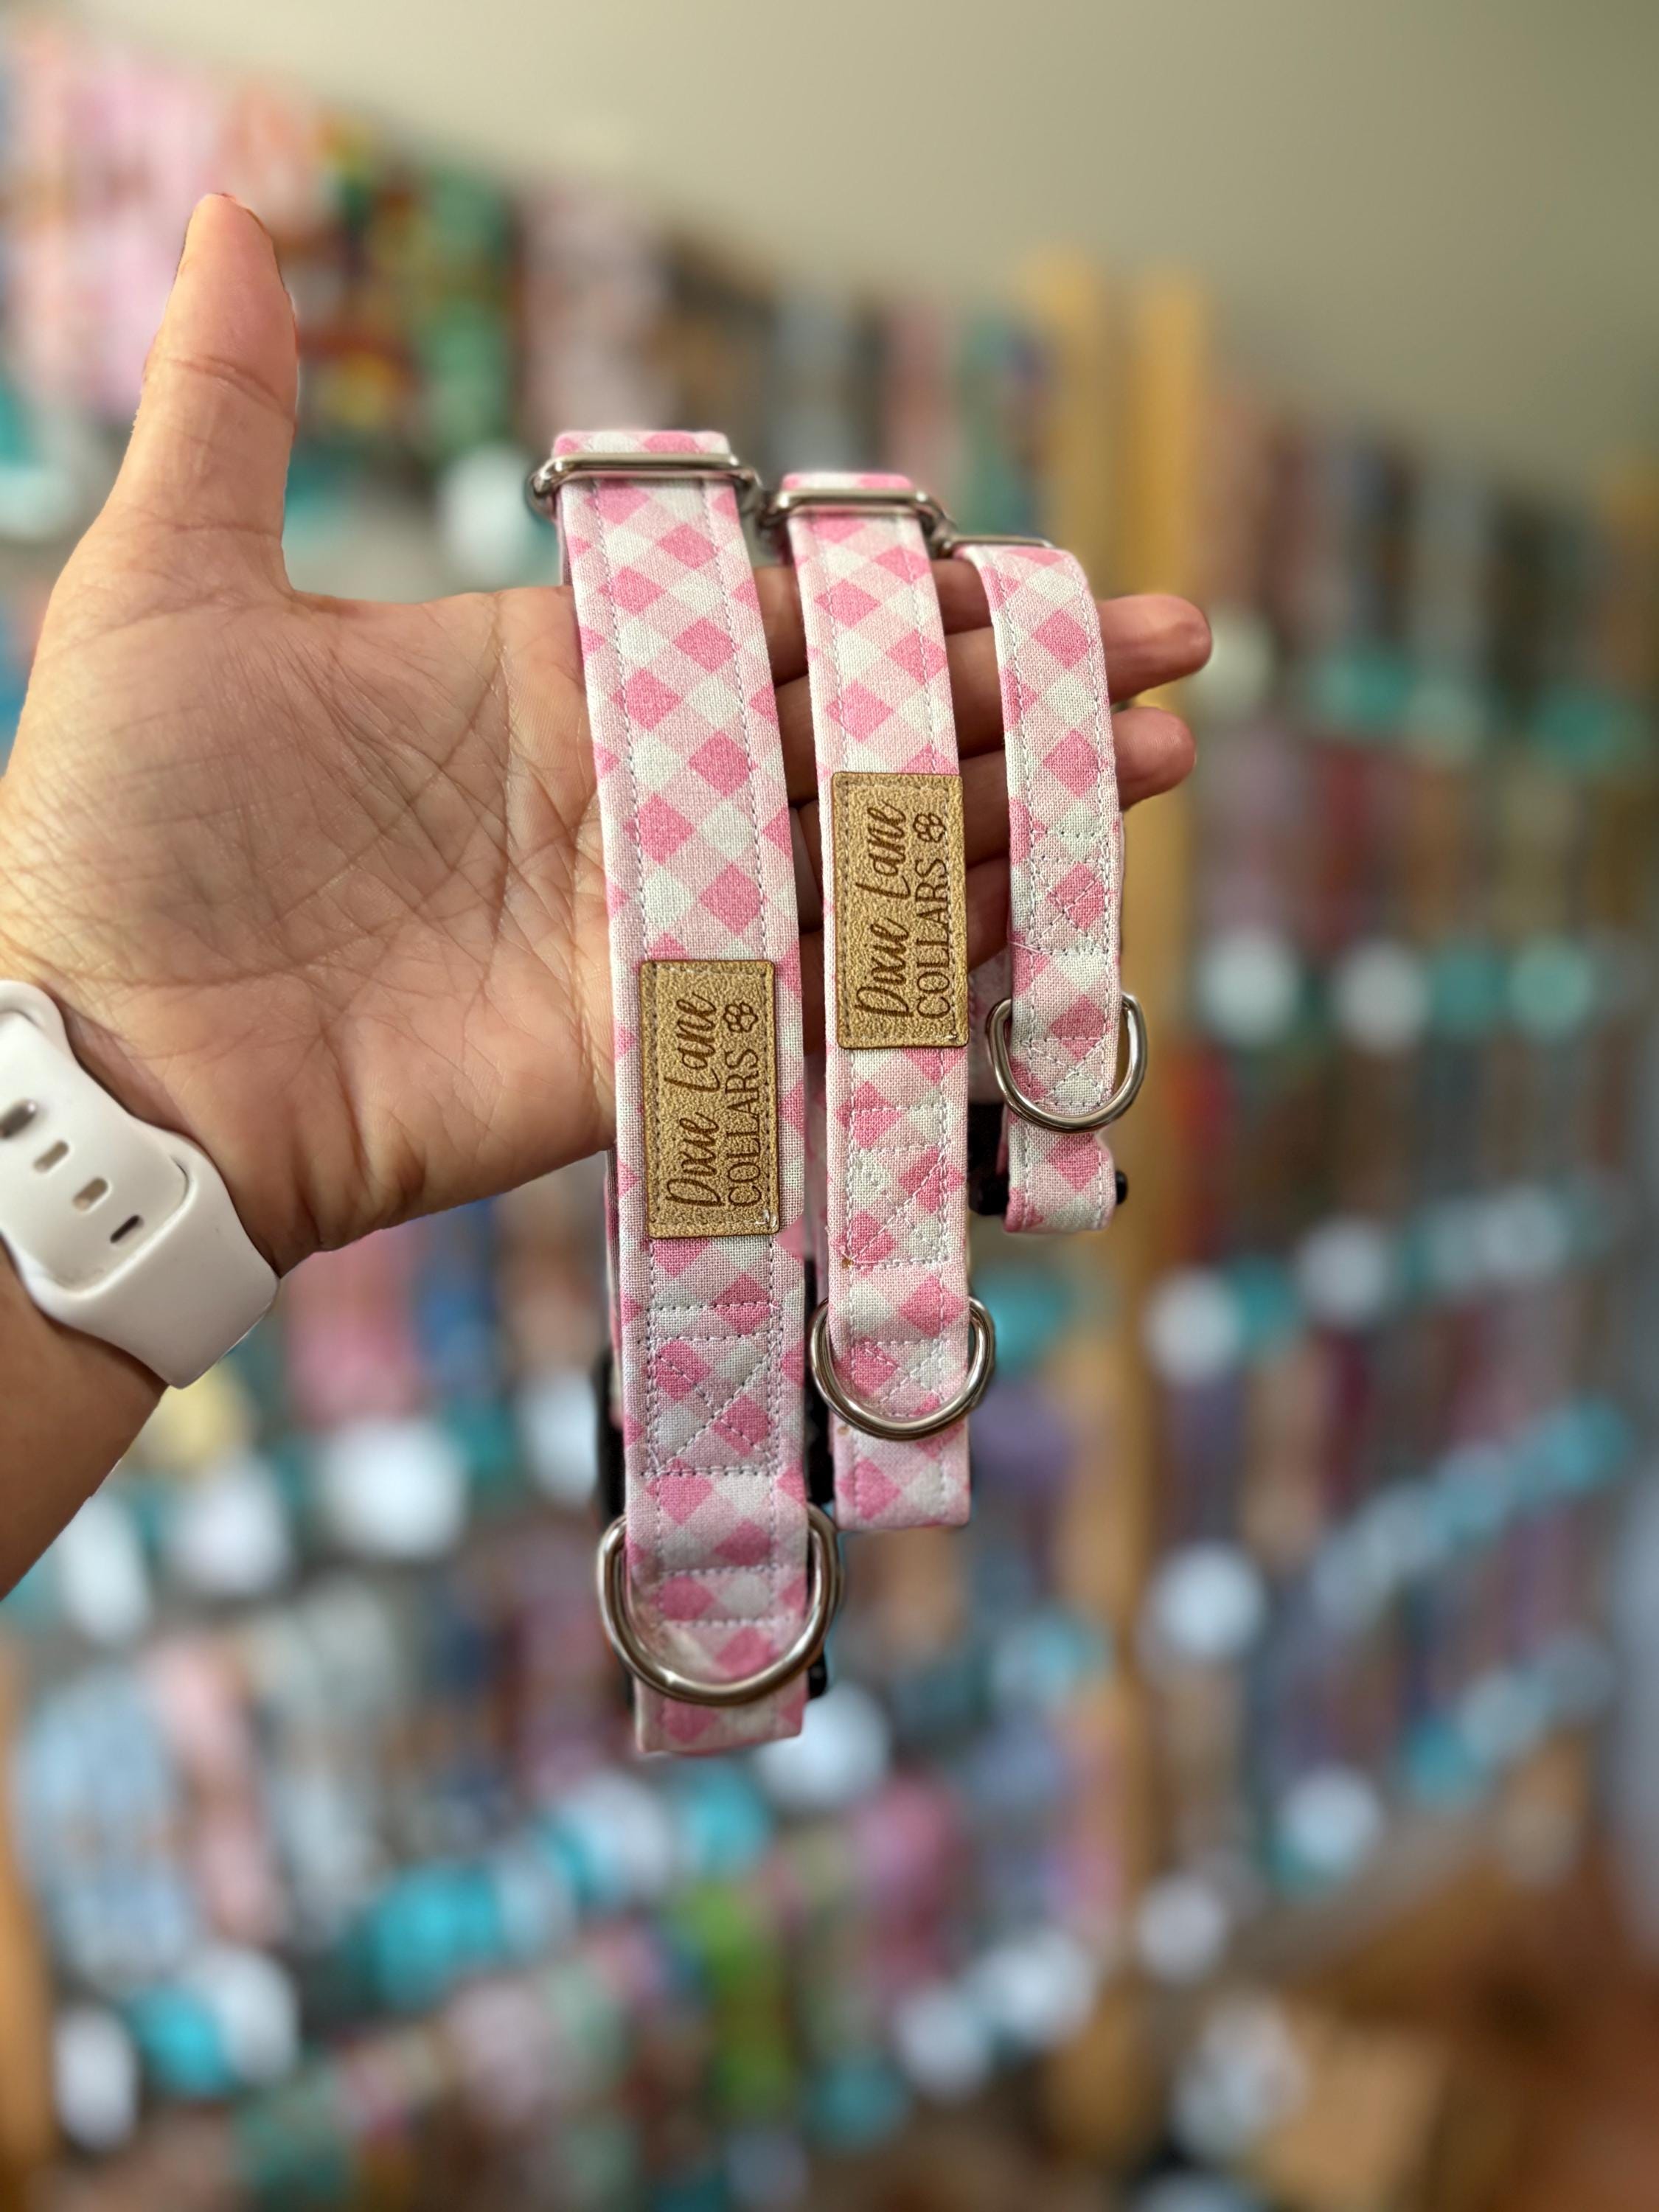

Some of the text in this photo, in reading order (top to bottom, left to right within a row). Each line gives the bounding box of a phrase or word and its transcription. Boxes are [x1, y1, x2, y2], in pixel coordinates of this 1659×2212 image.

[855, 801, 914, 1018] Dixie Lane
[915, 858, 951, 1019] COLLARS
[664, 992, 725, 1207] Dixie Lane
[724, 1048, 762, 1207] COLLARS
